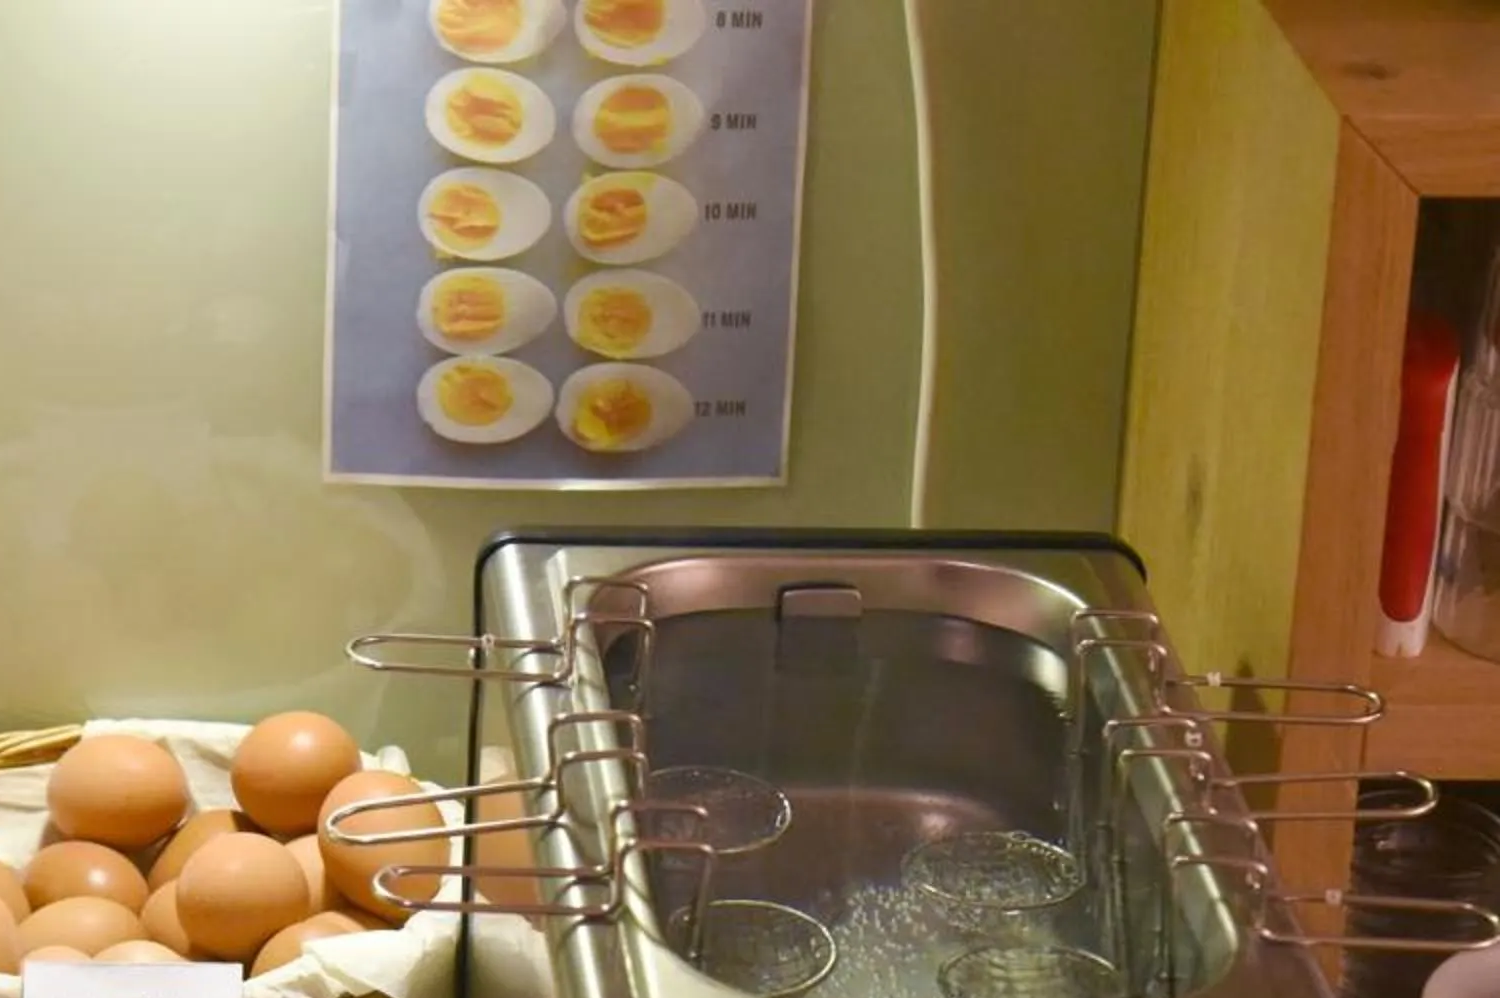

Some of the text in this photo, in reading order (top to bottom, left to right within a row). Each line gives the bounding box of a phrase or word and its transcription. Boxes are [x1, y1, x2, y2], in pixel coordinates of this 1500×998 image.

[731, 10, 764, 30] MIN
[710, 112, 757, 131] 9 MIN
[704, 201, 757, 221] 10 MIN
[702, 309, 752, 329] 11 MIN
[693, 399, 747, 418] 12 MIN
